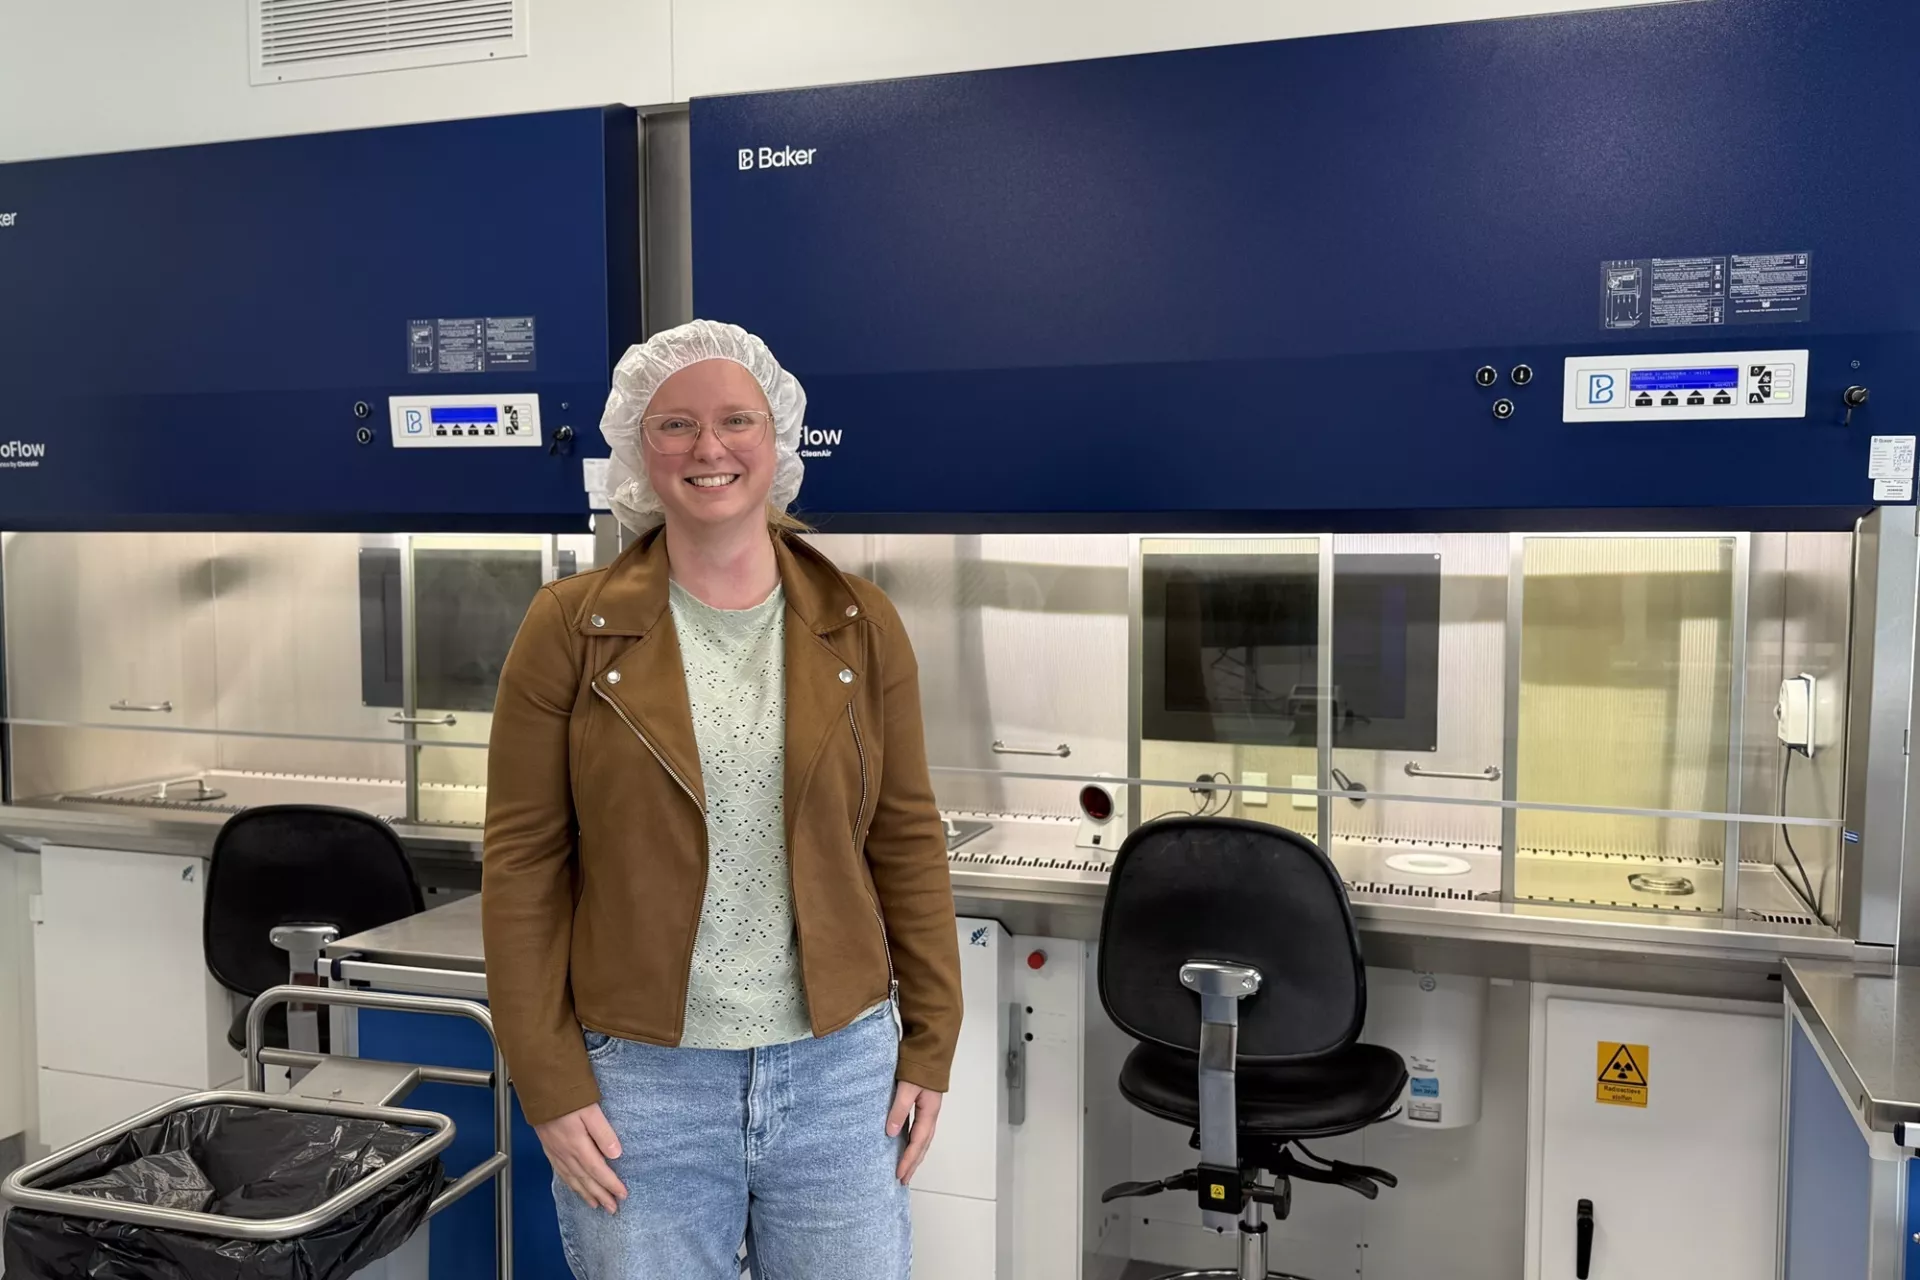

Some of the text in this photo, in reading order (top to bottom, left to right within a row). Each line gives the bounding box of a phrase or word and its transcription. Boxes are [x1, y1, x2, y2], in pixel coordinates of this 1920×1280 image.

[758, 144, 817, 169] Baker
[800, 425, 842, 445] low
[801, 449, 832, 457] CleanAir
